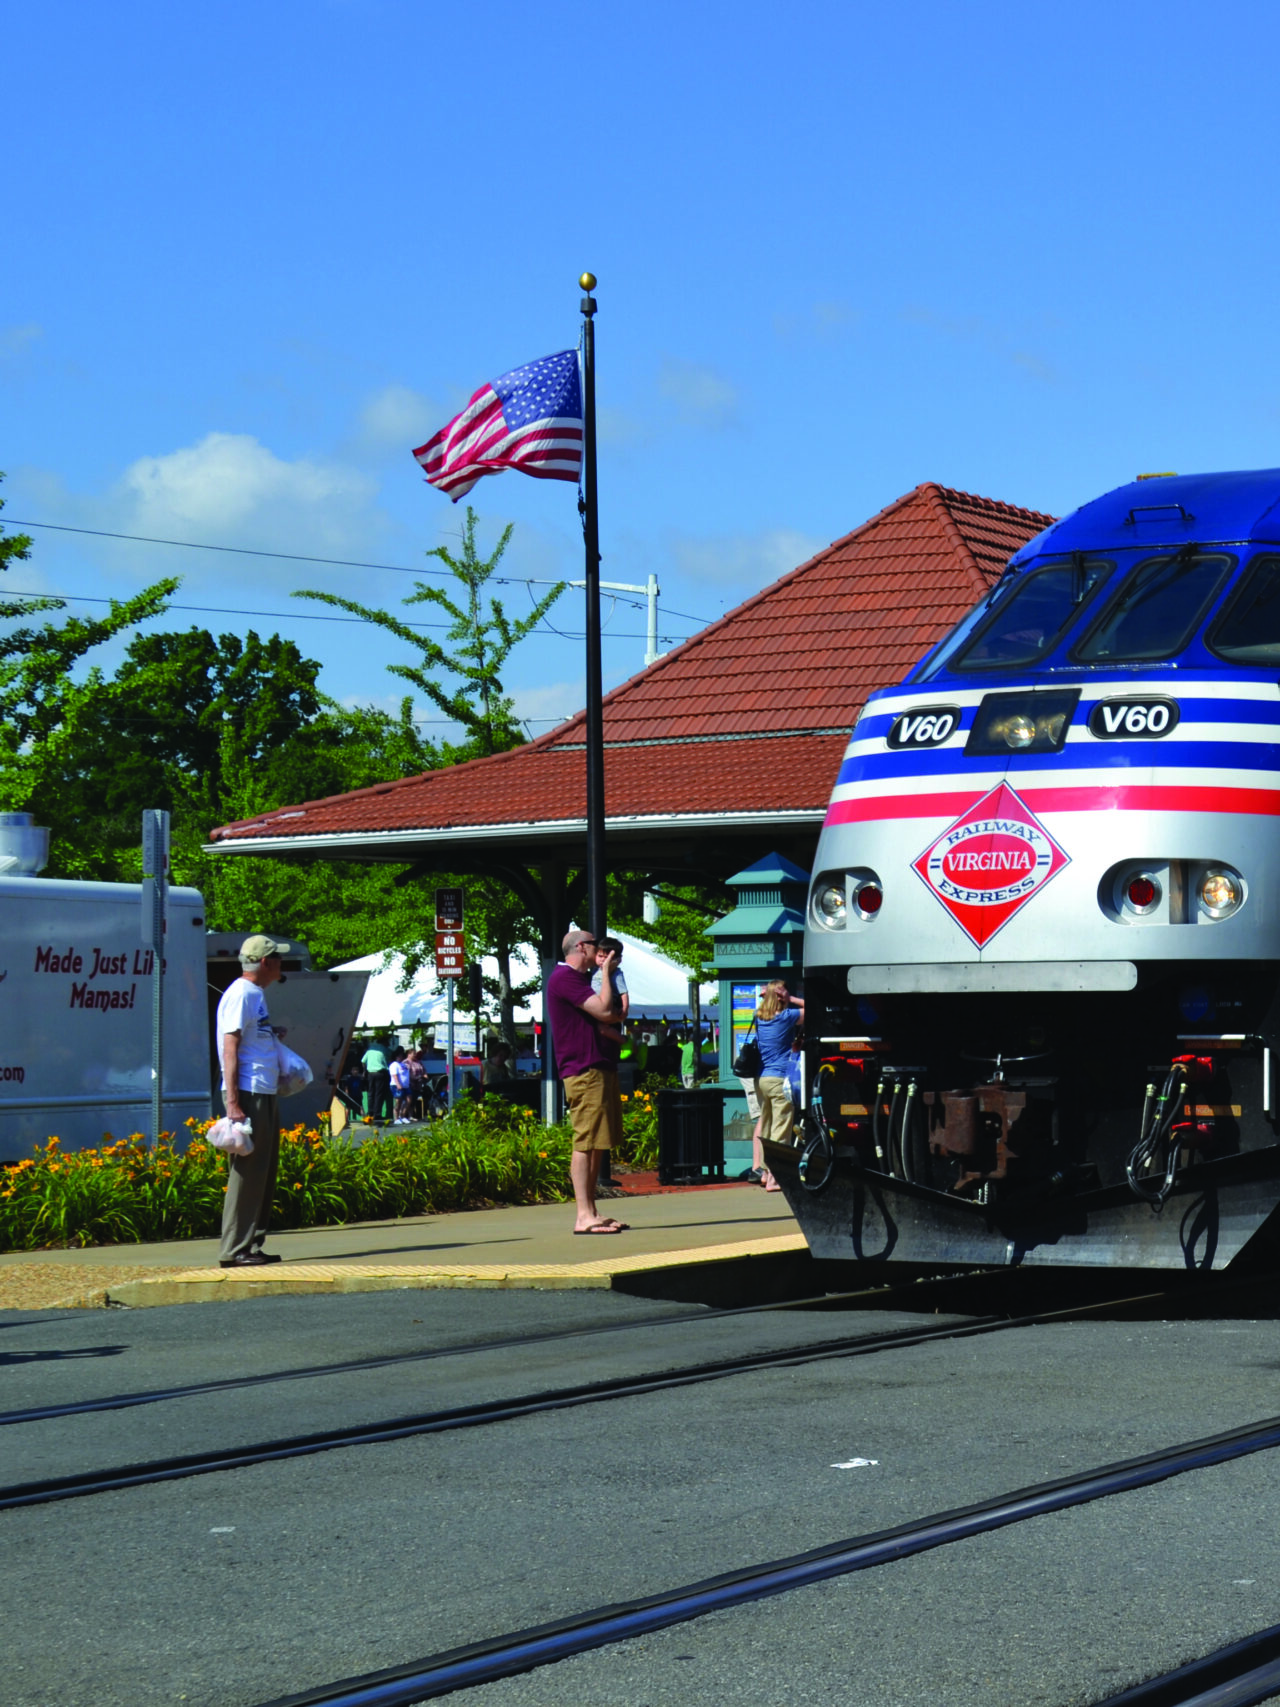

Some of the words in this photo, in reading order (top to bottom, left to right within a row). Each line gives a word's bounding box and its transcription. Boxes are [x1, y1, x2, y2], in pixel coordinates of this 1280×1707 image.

[899, 714, 953, 743] V60
[1102, 705, 1169, 733] V60
[946, 821, 1041, 846] RAILWAY
[946, 851, 1032, 872] VIRGINIA
[938, 877, 1035, 903] EXPRESS
[437, 946, 462, 954] BICYCLES
[443, 936, 456, 946] NO
[34, 945, 82, 973] Made
[88, 948, 127, 980] Just
[443, 956, 456, 966] NO
[70, 982, 137, 1013] Mamas!
